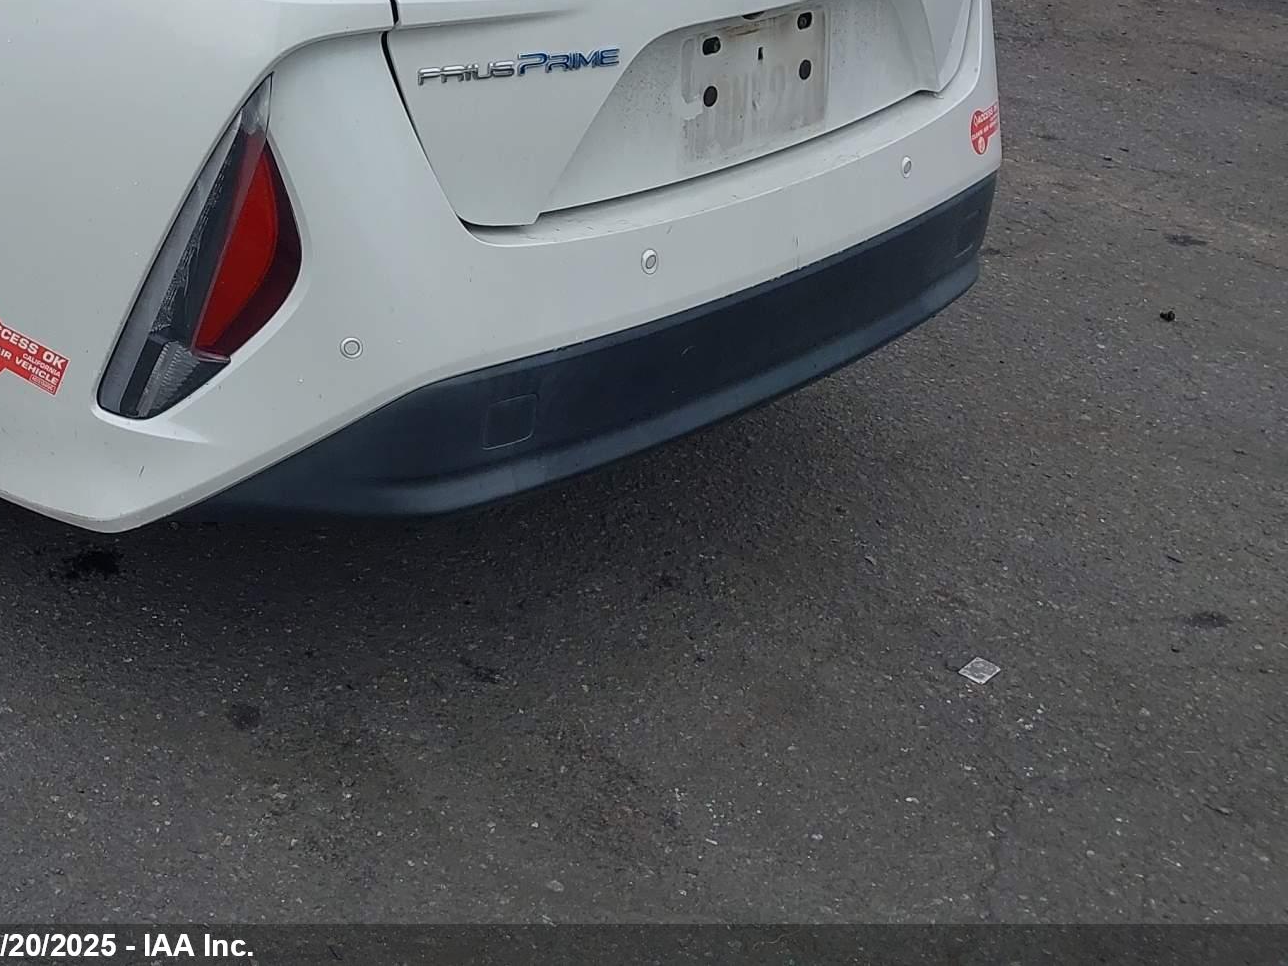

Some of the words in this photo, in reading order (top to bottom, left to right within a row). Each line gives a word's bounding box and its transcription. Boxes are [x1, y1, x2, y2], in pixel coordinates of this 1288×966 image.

[417, 60, 515, 86] PRIUS
[517, 47, 620, 77] PRIME
[15, 356, 59, 386] VEHICLE
[23, 353, 61, 377] CALIFORNIA
[42, 350, 66, 369] OK
